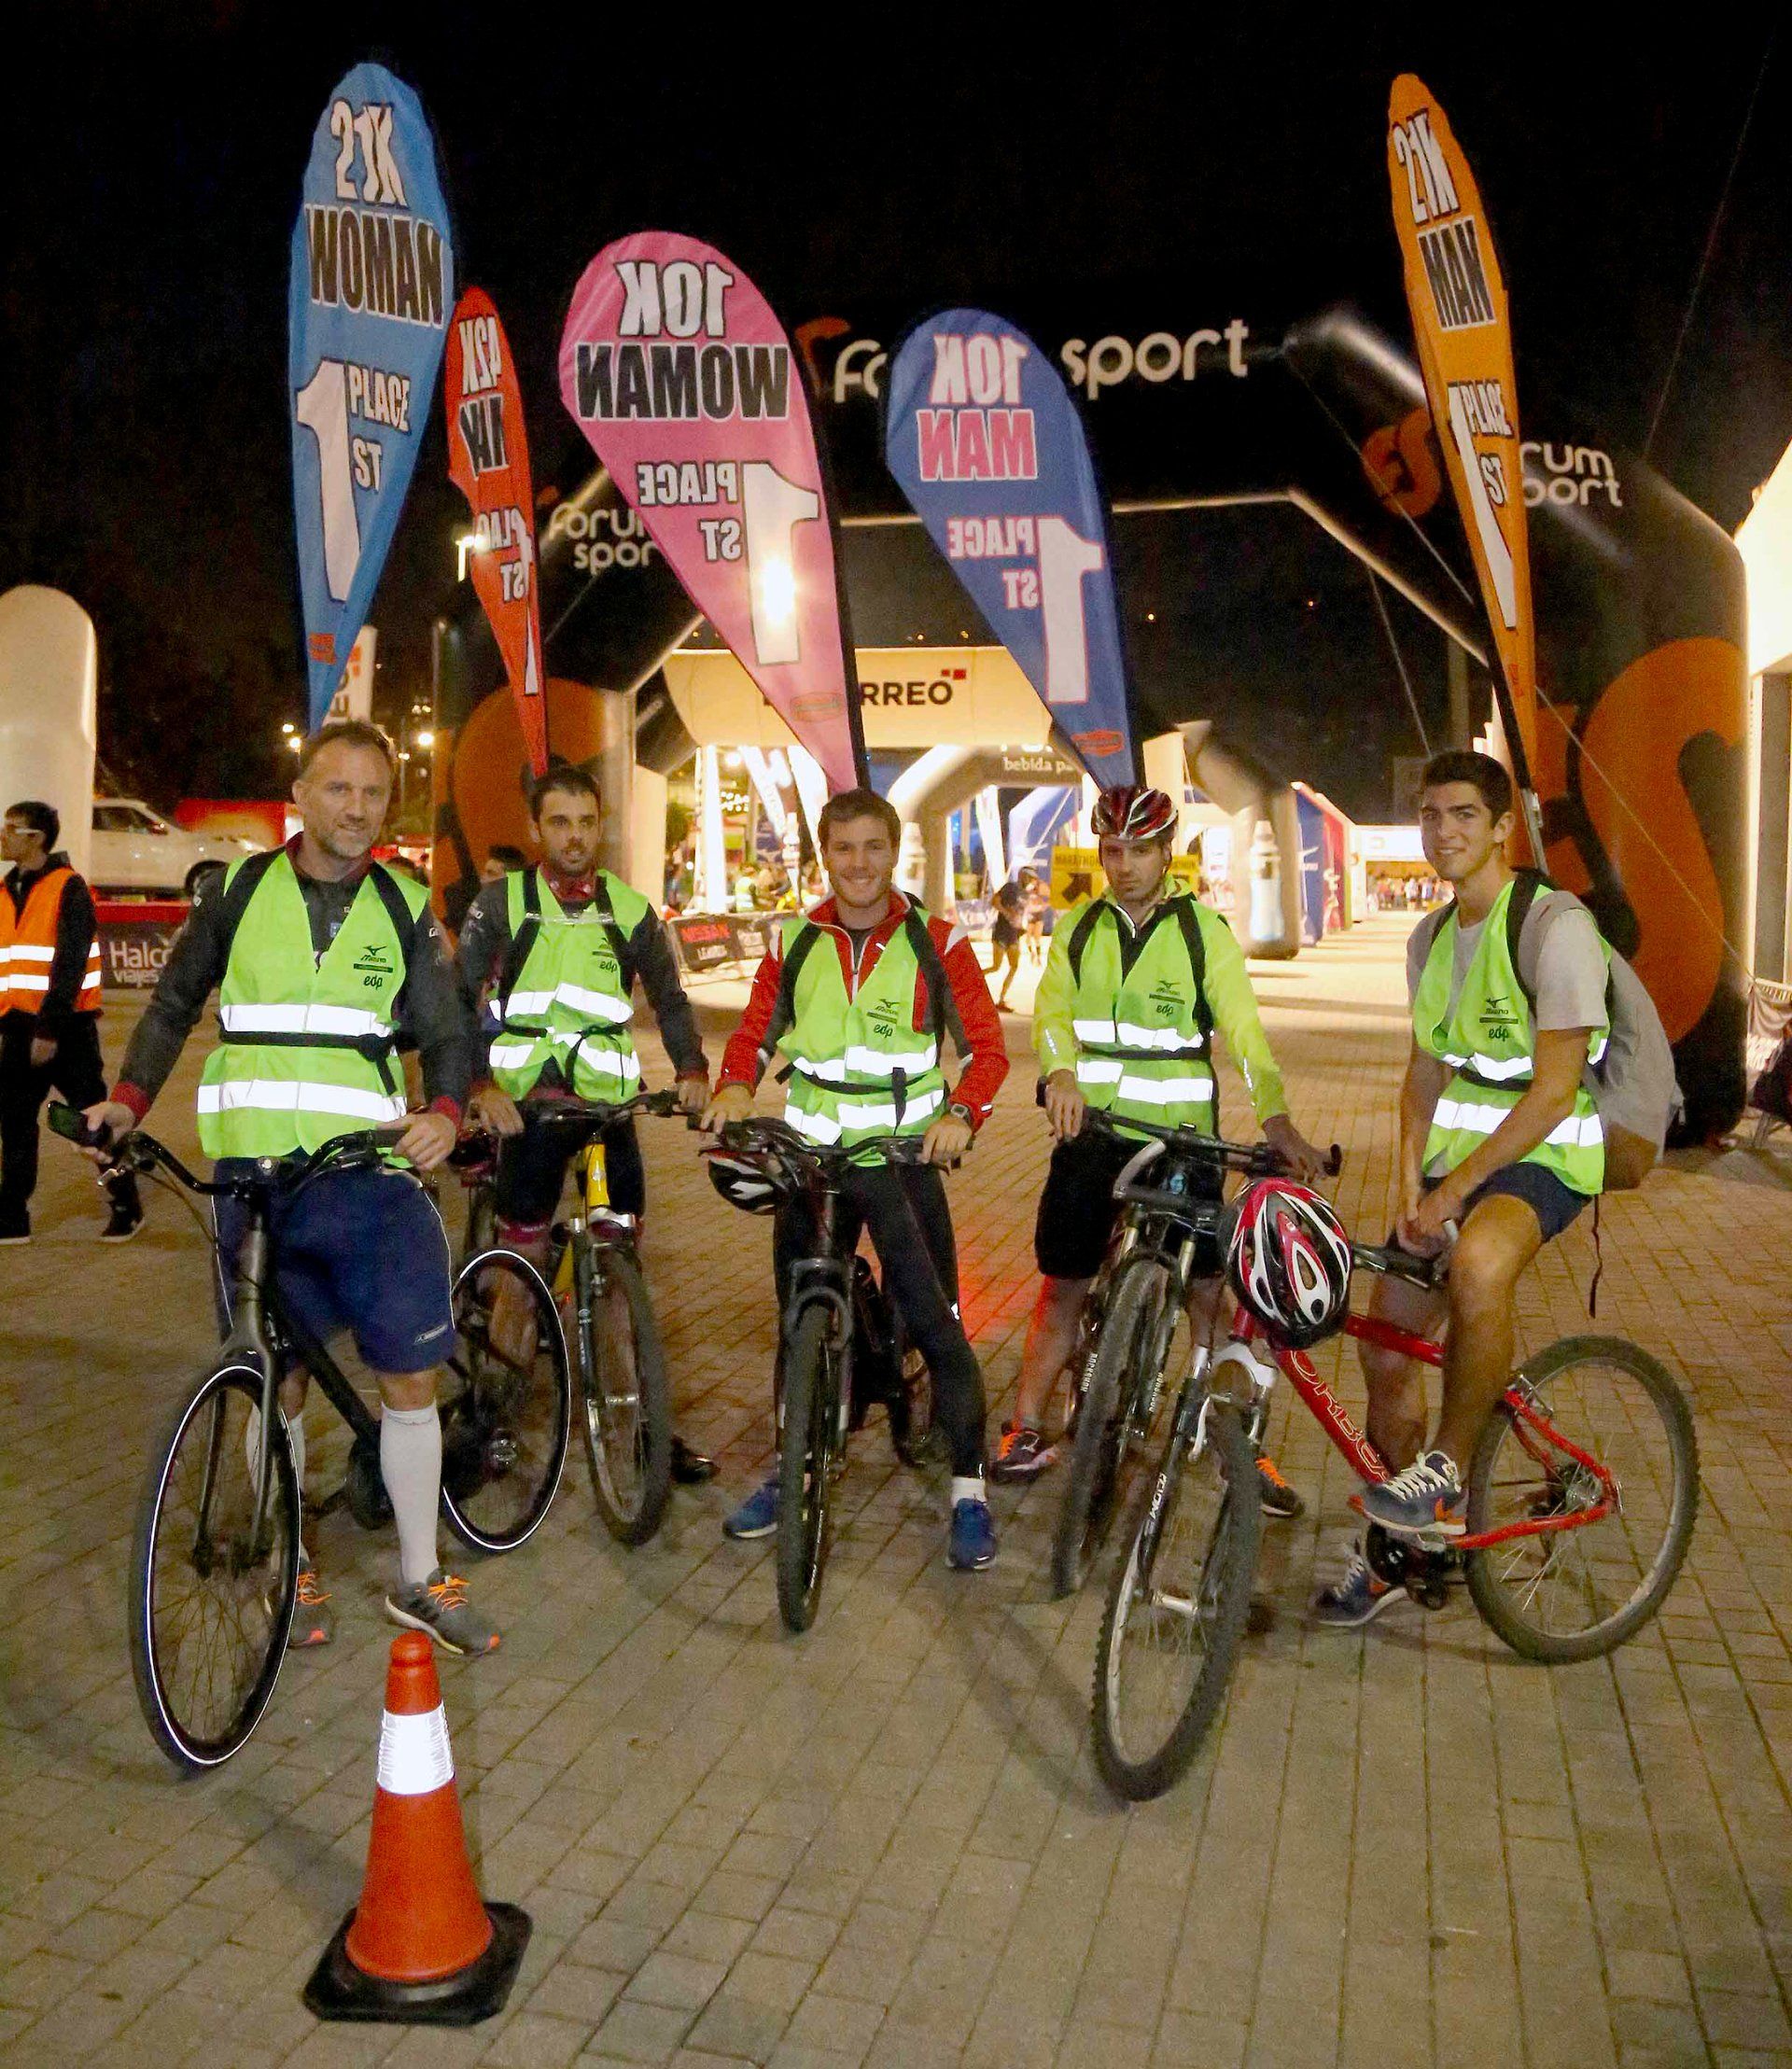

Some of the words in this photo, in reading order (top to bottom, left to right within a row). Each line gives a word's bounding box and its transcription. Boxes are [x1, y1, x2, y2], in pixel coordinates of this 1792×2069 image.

[330, 97, 408, 208] 21K
[1393, 107, 1461, 226] 21K
[304, 203, 448, 329] WOMAN
[1416, 216, 1497, 331] MAN
[1060, 319, 1249, 400] sport
[348, 362, 411, 434] PLACE
[351, 434, 382, 492] ST
[1519, 441, 1615, 482] rum
[1522, 477, 1623, 508] port
[573, 540, 659, 575] spor
[860, 681, 953, 706] RREO
[1002, 756, 1054, 772] bebida
[363, 974, 384, 989] edp
[599, 959, 619, 973] edp
[1155, 1003, 1174, 1017] edp
[873, 1023, 893, 1039] edp
[1488, 1026, 1509, 1041] edp
